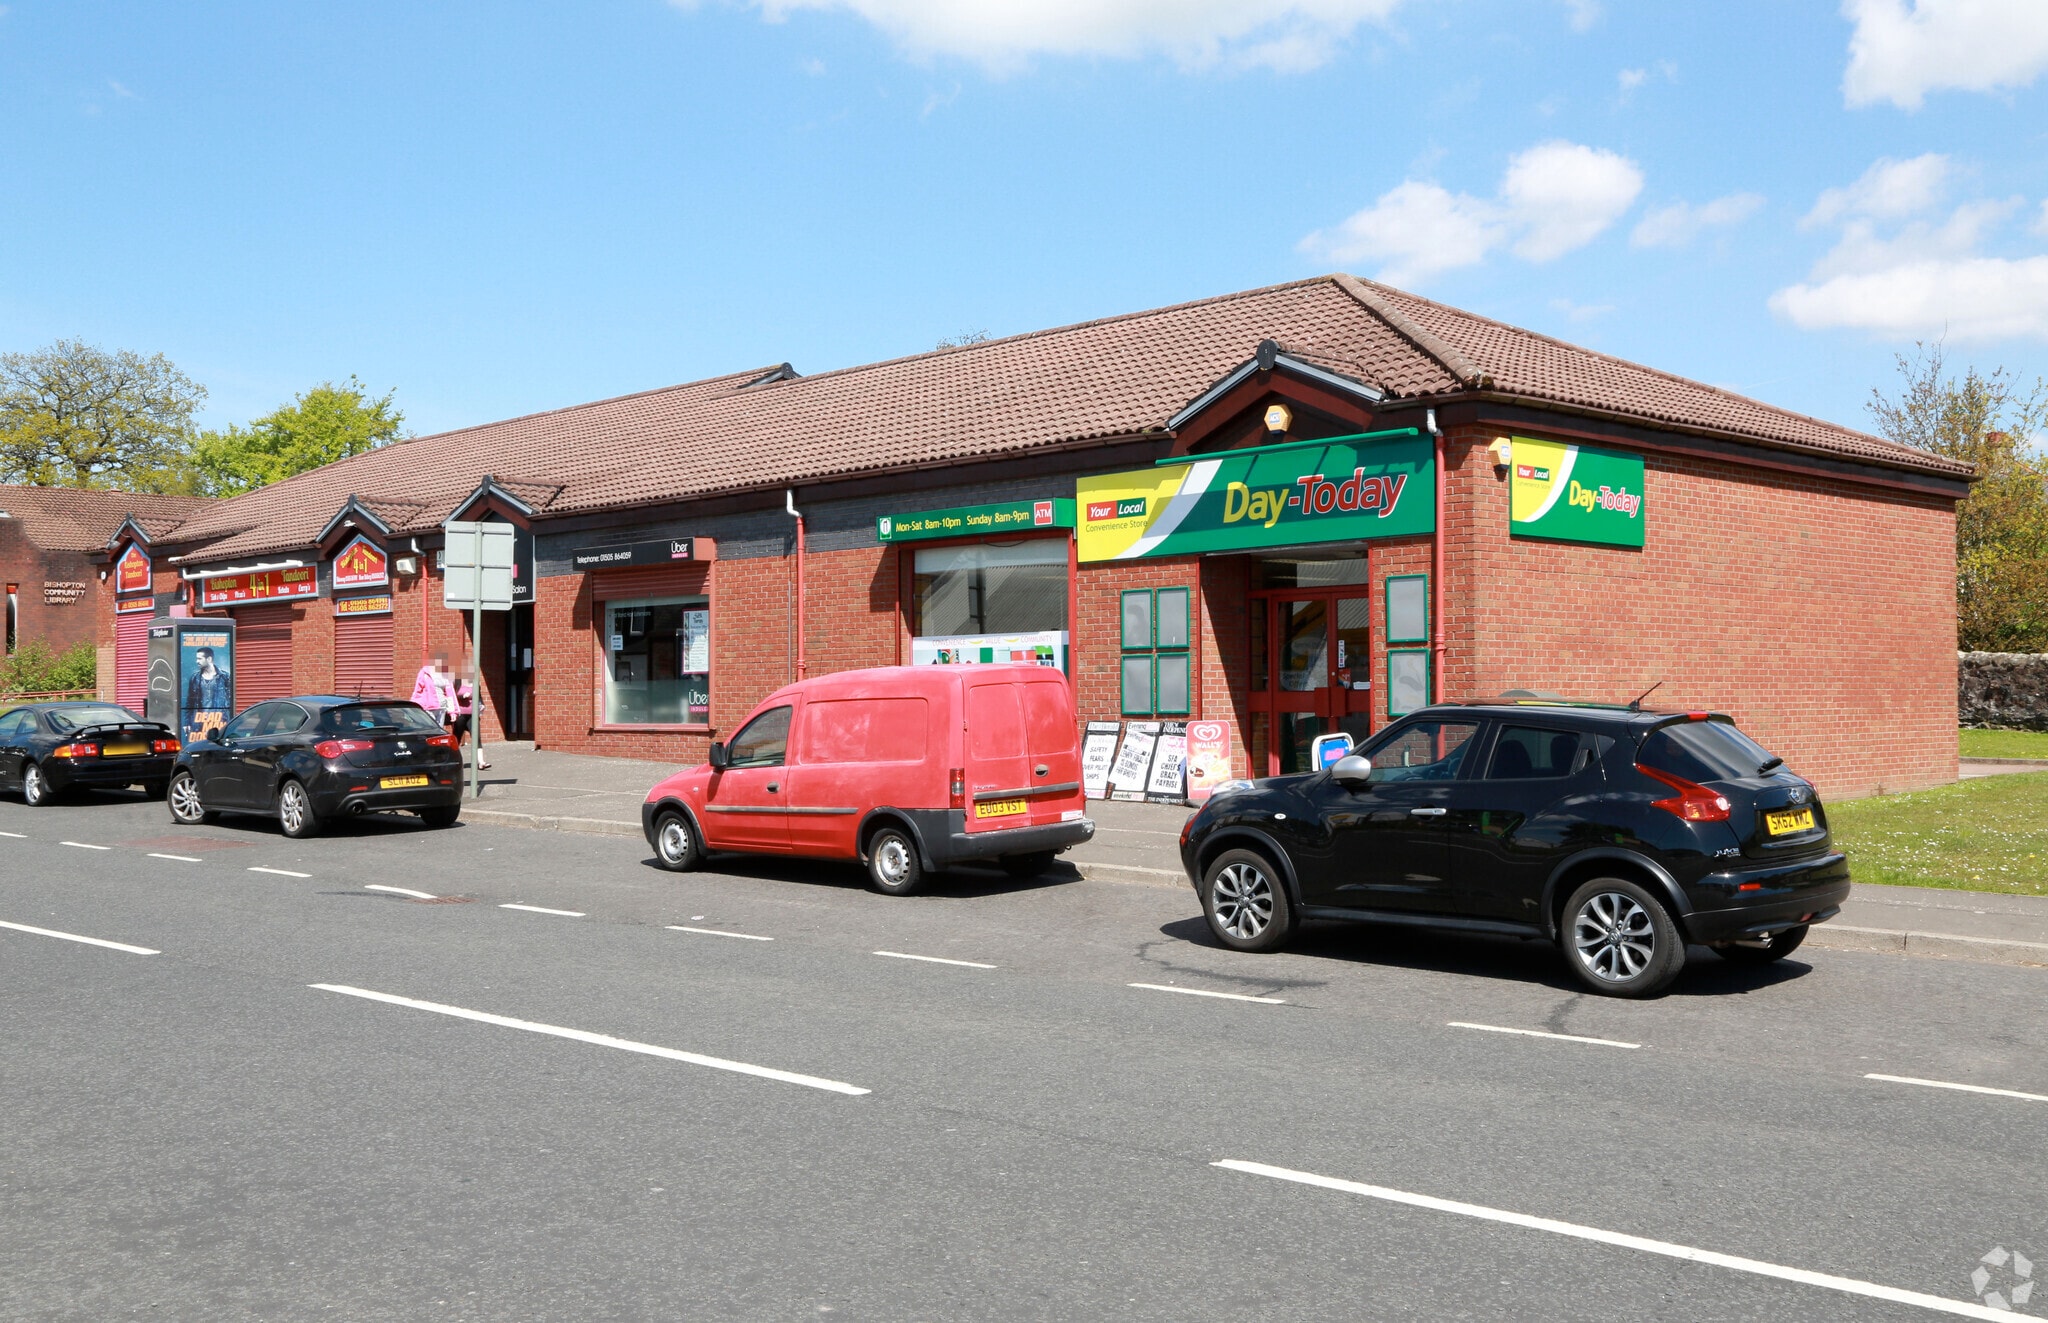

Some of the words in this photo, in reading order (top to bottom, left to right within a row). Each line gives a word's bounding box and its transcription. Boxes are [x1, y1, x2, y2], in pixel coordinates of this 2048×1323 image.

[1518, 467, 1531, 476] Your
[1534, 470, 1549, 479] Local
[1223, 467, 1408, 529] Day-Today
[1569, 480, 1641, 518] Day-Today
[1036, 508, 1051, 519] ATM
[1089, 505, 1112, 518] Your
[1118, 501, 1145, 515] Local
[896, 521, 923, 532] Mon-Sat
[925, 517, 961, 530] 8am-10pm
[966, 514, 992, 526] Sunday
[995, 511, 1030, 523] 8am-9pm
[1086, 521, 1127, 532] Convenience
[1129, 519, 1148, 529] Store
[281, 568, 309, 583] Tandoori
[44, 581, 86, 589] BISHOPTON
[1021, 635, 1053, 643] COMMUNITY
[689, 689, 709, 704] Übe
[194, 712, 222, 723] DEAD
[1168, 754, 1178, 762] SFA
[1160, 771, 1177, 779] CRAZY
[1007, 800, 1022, 812] VST
[1771, 813, 1793, 830] SK62
